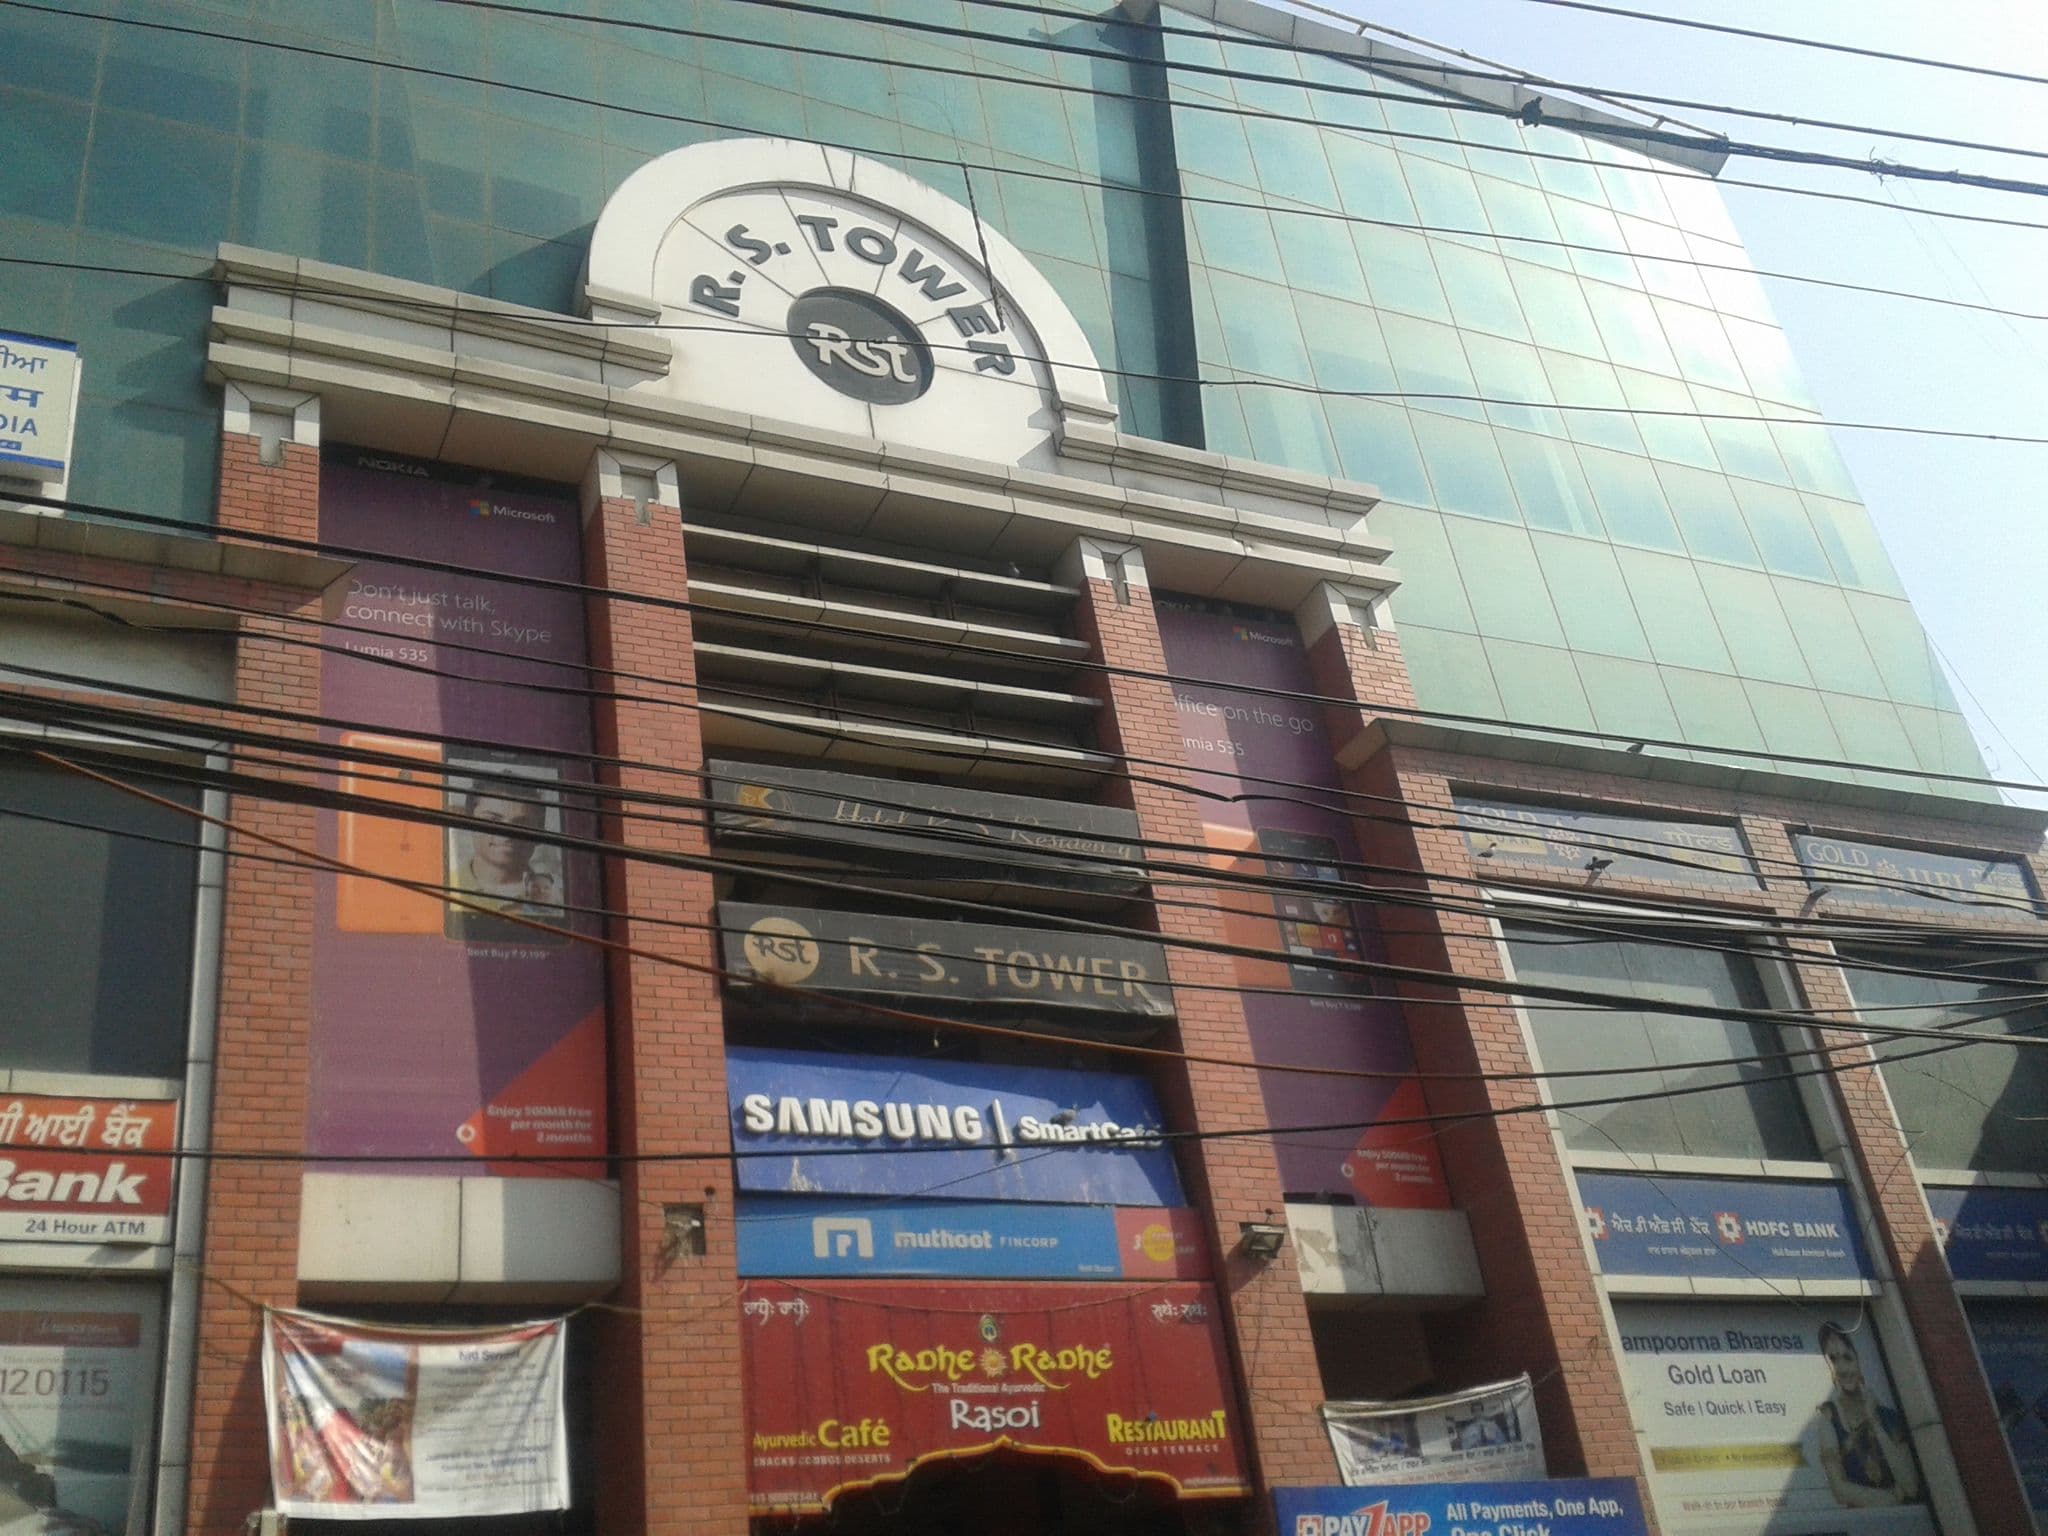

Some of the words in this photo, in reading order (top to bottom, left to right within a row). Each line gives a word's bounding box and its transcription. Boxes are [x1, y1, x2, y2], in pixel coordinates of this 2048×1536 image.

[798, 213, 1017, 377] TOWER
[358, 456, 430, 478] NOKIA
[493, 503, 557, 524] Microsoft
[410, 588, 448, 607] just
[454, 594, 497, 616] talk,
[345, 604, 435, 628] connect
[439, 615, 485, 634] with
[490, 619, 552, 643] Skype
[399, 647, 430, 663] 535
[1173, 693, 1218, 717] ffice
[1222, 705, 1250, 722] on
[1253, 705, 1284, 728] the
[1288, 716, 1314, 735] go
[1216, 739, 1246, 756] 535
[1806, 842, 1869, 867] GOLD
[974, 946, 1153, 1007] TOWER
[742, 1093, 983, 1143] SAMSUNG
[25, 1218, 48, 1234] 24
[53, 1219, 98, 1234] Hour
[104, 1220, 146, 1236] ATM
[893, 1228, 993, 1250] muthoot
[1000, 1236, 1059, 1249] FINCORP
[1746, 1220, 1791, 1238] HDFC
[1793, 1222, 1839, 1239] BANK
[1622, 1334, 1721, 1356] ampoorna
[1726, 1330, 1804, 1351] Bharosa
[1668, 1364, 1715, 1385] Gold
[1718, 1364, 1767, 1384] Loan
[951, 1398, 1041, 1432] Rasoi
[1664, 1401, 1695, 1417] Safe
[1706, 1400, 1746, 1417] Quick
[1755, 1399, 1787, 1417] Easy
[752, 1431, 817, 1451] Ayurvedic
[817, 1418, 891, 1449] Café
[1447, 1503, 1468, 1521] All
[1471, 1501, 1554, 1523] Payments,
[1555, 1498, 1586, 1517] One
[1588, 1497, 1624, 1518] App,
